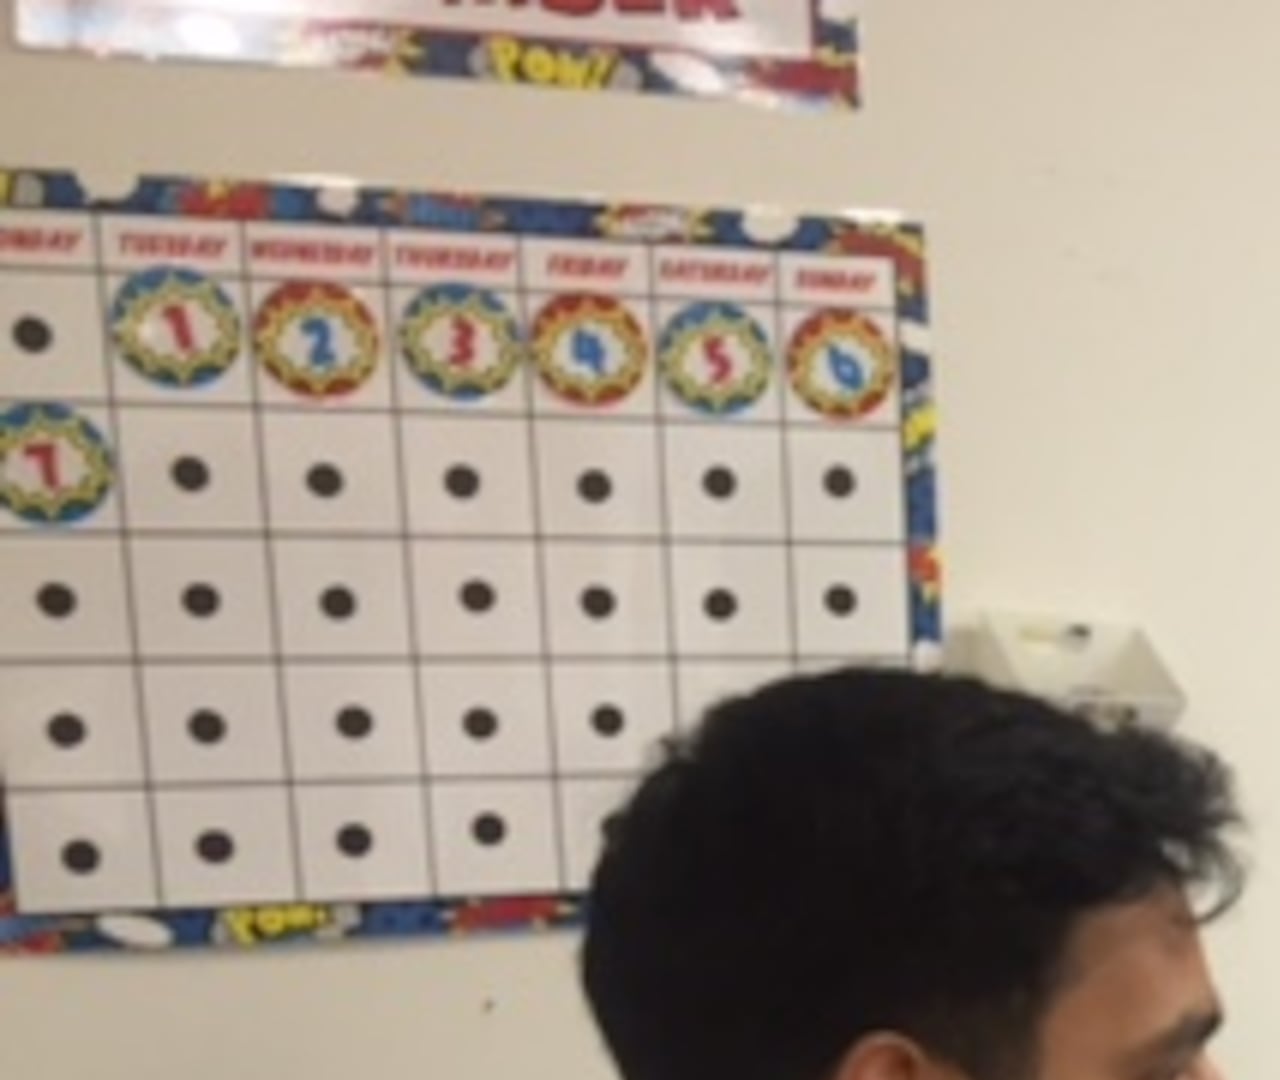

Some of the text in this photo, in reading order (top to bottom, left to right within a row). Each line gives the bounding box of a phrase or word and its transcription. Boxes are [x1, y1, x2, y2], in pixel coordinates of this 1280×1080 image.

[489, 34, 620, 89] POW!
[118, 231, 229, 257] TUESDAY
[251, 239, 374, 264] WEDNESDAY
[395, 246, 516, 272] THURSDAY
[546, 254, 629, 279] FRIDAY
[659, 260, 773, 285] SATURDAY
[793, 269, 877, 292] SUNDAY
[162, 303, 195, 351] 1
[300, 315, 337, 368] 2
[448, 317, 475, 368] 3
[571, 322, 607, 372] 4
[700, 336, 734, 384] 5
[826, 341, 865, 390] 6
[22, 444, 60, 489] 7
